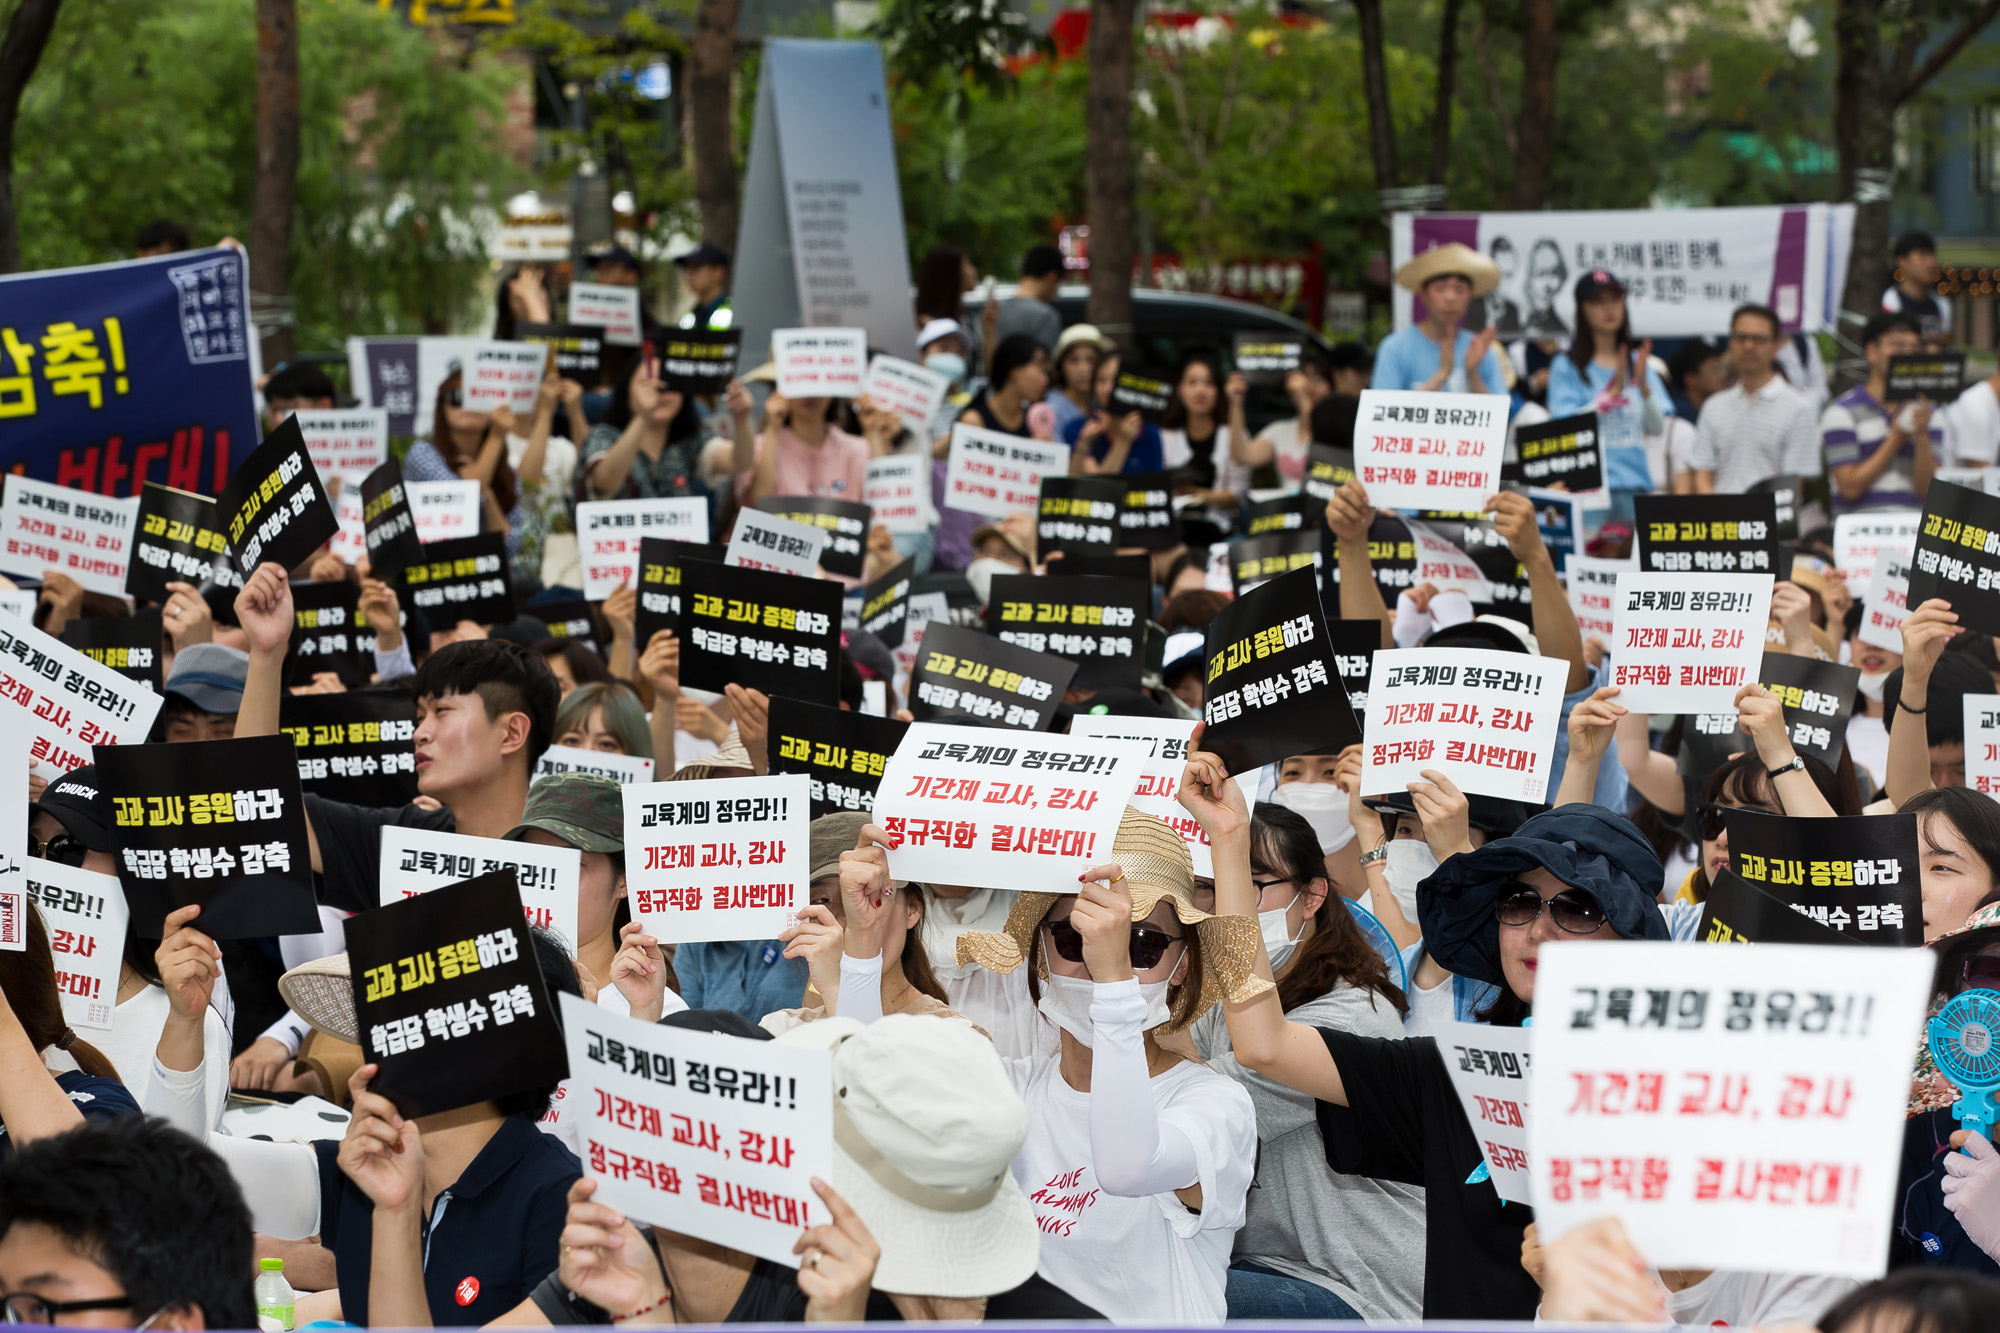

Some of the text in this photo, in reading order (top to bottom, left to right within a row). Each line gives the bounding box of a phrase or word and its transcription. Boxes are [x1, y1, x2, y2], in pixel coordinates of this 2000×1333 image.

[1372, 405, 1491, 427] 교육계의 정유라!!
[1372, 435, 1485, 458] 기간제 교사, 강사
[1363, 466, 1489, 489] 정규직화 결사반대!
[17, 490, 127, 529] 교육계의 정유라!!
[229, 451, 303, 545] 교과 교사 증원하라
[17, 515, 56, 538] 기간제
[95, 533, 122, 552] 강사
[143, 513, 195, 544] 교과 교사
[240, 482, 316, 572] 학급당 학생수 감축
[741, 525, 813, 559] 교육계의 정유라!!
[1649, 520, 1768, 541] 교과 교사 증원하라
[1924, 513, 1961, 543] 교과 교사
[6, 539, 126, 577] 정규직화 결사반대!
[138, 542, 213, 580] 학급당 학생수
[644, 563, 664, 584] 교과
[1651, 551, 1769, 570] 학급당 학생수 감축
[1917, 547, 1974, 584] 학급당 학생수
[693, 594, 830, 635] 교과 교사 증원하라
[1001, 602, 1135, 627] 교과 교사 증원하라
[1627, 592, 1752, 613] 교육계의 정유라!!
[319, 633, 348, 654] 감축
[692, 627, 827, 671] 학급당 학생수 감축
[1049, 632, 1133, 657] 학생수 감축
[1208, 613, 1314, 685] 교과 교사 증원하라
[1626, 628, 1668, 648] 기간제
[1672, 628, 1706, 651] 교사,
[1711, 629, 1744, 649] 강사
[0, 629, 136, 722] 교육계의 정유라!!
[925, 652, 1052, 701] 교과 교사 증원하라
[1386, 666, 1542, 695] 교육계의 정유라!!
[1616, 665, 1745, 687] 정규직화 결사반대!
[918, 682, 1040, 729] 학급당 학생수 감축
[1206, 659, 1328, 726] 학급당 학생수 감축
[33, 695, 72, 735] 교사,
[1383, 703, 1533, 732] 기간제 교사, 강사
[313, 720, 415, 746] 교사 증원하라
[1793, 723, 1831, 750] 감축
[330, 752, 415, 777] 학생수 감축
[779, 735, 847, 768] 교과 교사
[918, 742, 1119, 776] 교육계의 정유라!!
[1372, 739, 1536, 774] 정규직화 결사반대!
[55, 781, 99, 801] CHUCK
[906, 776, 1099, 811] 기간제 교사, 강사
[112, 788, 285, 828] 교과 교사 증원하라
[641, 797, 788, 828] 교육계의 정유라!!
[884, 816, 1097, 859] 정규직화 결사반대!
[122, 841, 291, 880] 학급당 학생수 감축
[400, 849, 475, 878] 교육계의
[644, 839, 785, 870] 기간제 교사, 강사
[1741, 853, 1902, 886] 교과 교사 증원하라
[27, 879, 105, 920] 정유라!!
[637, 883, 795, 914] 정규직화 결사반대!
[1857, 903, 1904, 931] 감축
[52, 928, 97, 958] 강사
[363, 927, 519, 1003] 교과 교사 증원하라
[370, 984, 535, 1058] 학급당 학생수 감축
[1568, 986, 1875, 1036] 교육계의 정유라!!
[586, 1029, 797, 1110] 교육계의 정유라!!
[1454, 1046, 1522, 1079] 교육계의
[1473, 1095, 1524, 1128] 기간제
[1567, 1071, 1853, 1121] 기간제 교사, 강사
[594, 1087, 794, 1168] 기간제 교사, 강사
[589, 1139, 809, 1229] 정규직화 결사반대!
[1045, 1166, 1087, 1190] LOVE
[1546, 1156, 1861, 1209] 정규직화 결사반대!
[1030, 1188, 1100, 1217] ALWAYS
